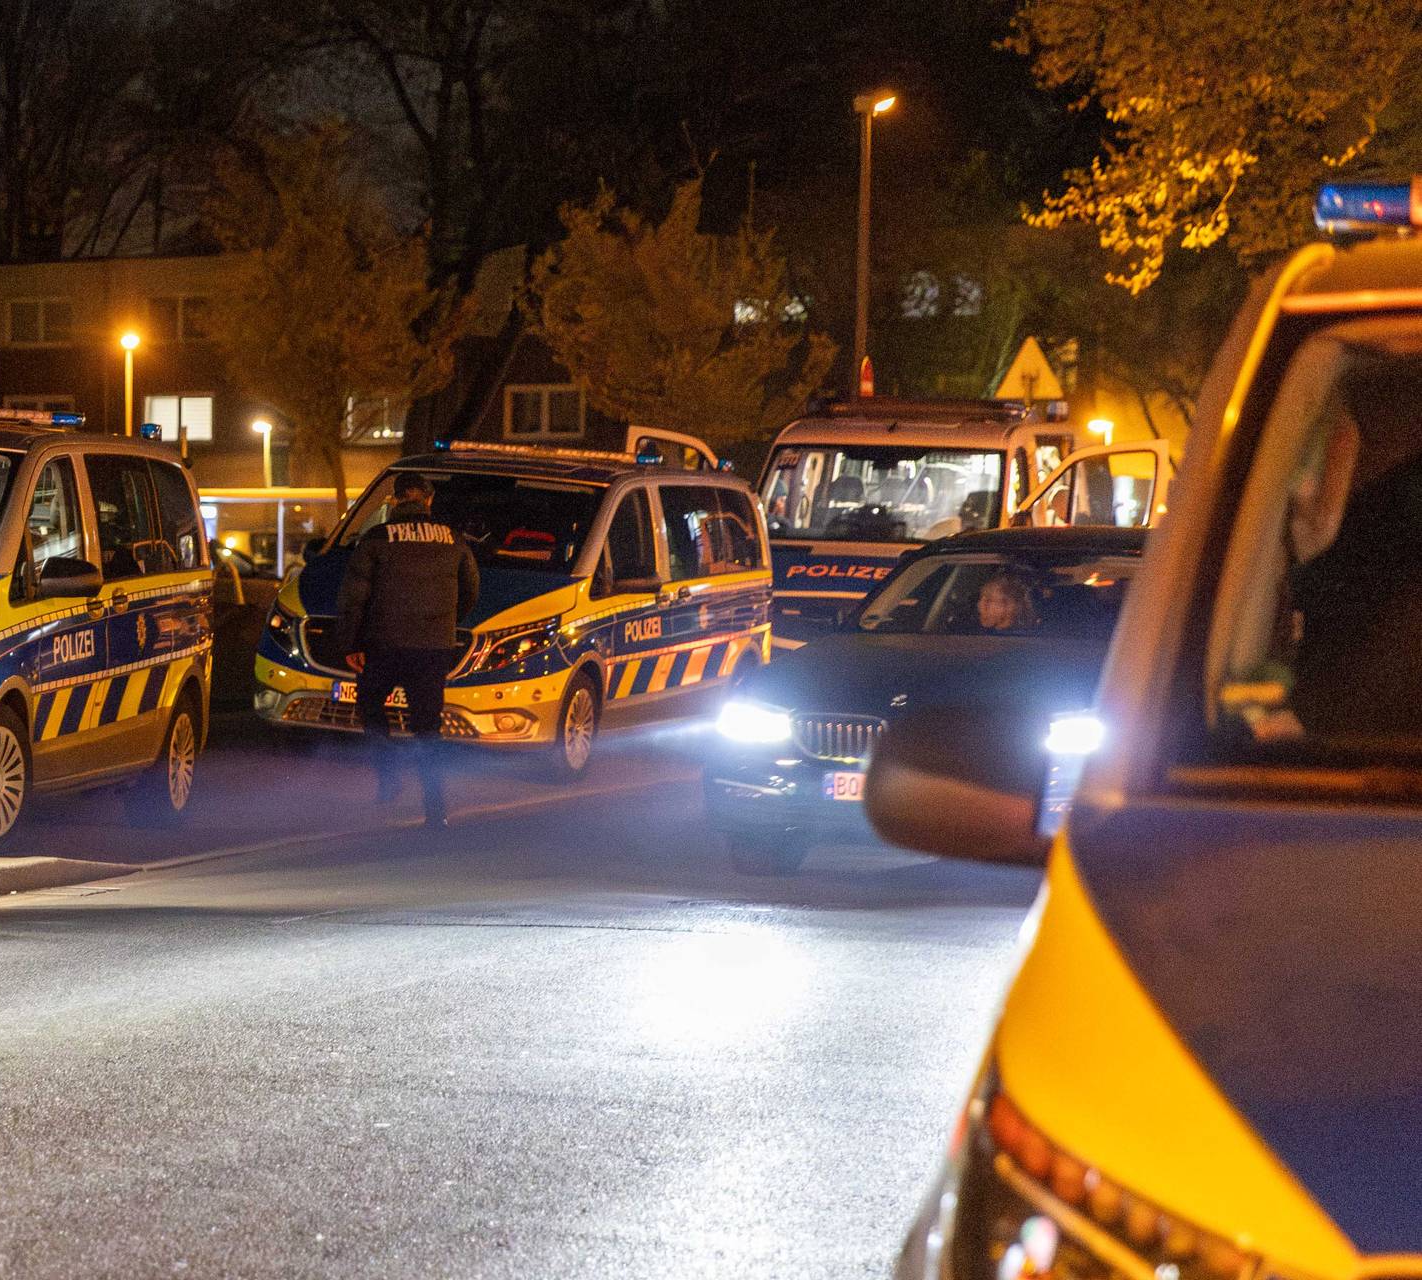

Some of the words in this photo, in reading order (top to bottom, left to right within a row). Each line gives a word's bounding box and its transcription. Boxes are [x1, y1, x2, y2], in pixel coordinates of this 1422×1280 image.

[386, 522, 455, 545] PEGADOR
[785, 563, 895, 580] POLIZE
[624, 615, 662, 643] POLIZEI
[52, 628, 95, 665] POLIZEI
[340, 685, 358, 700] NR
